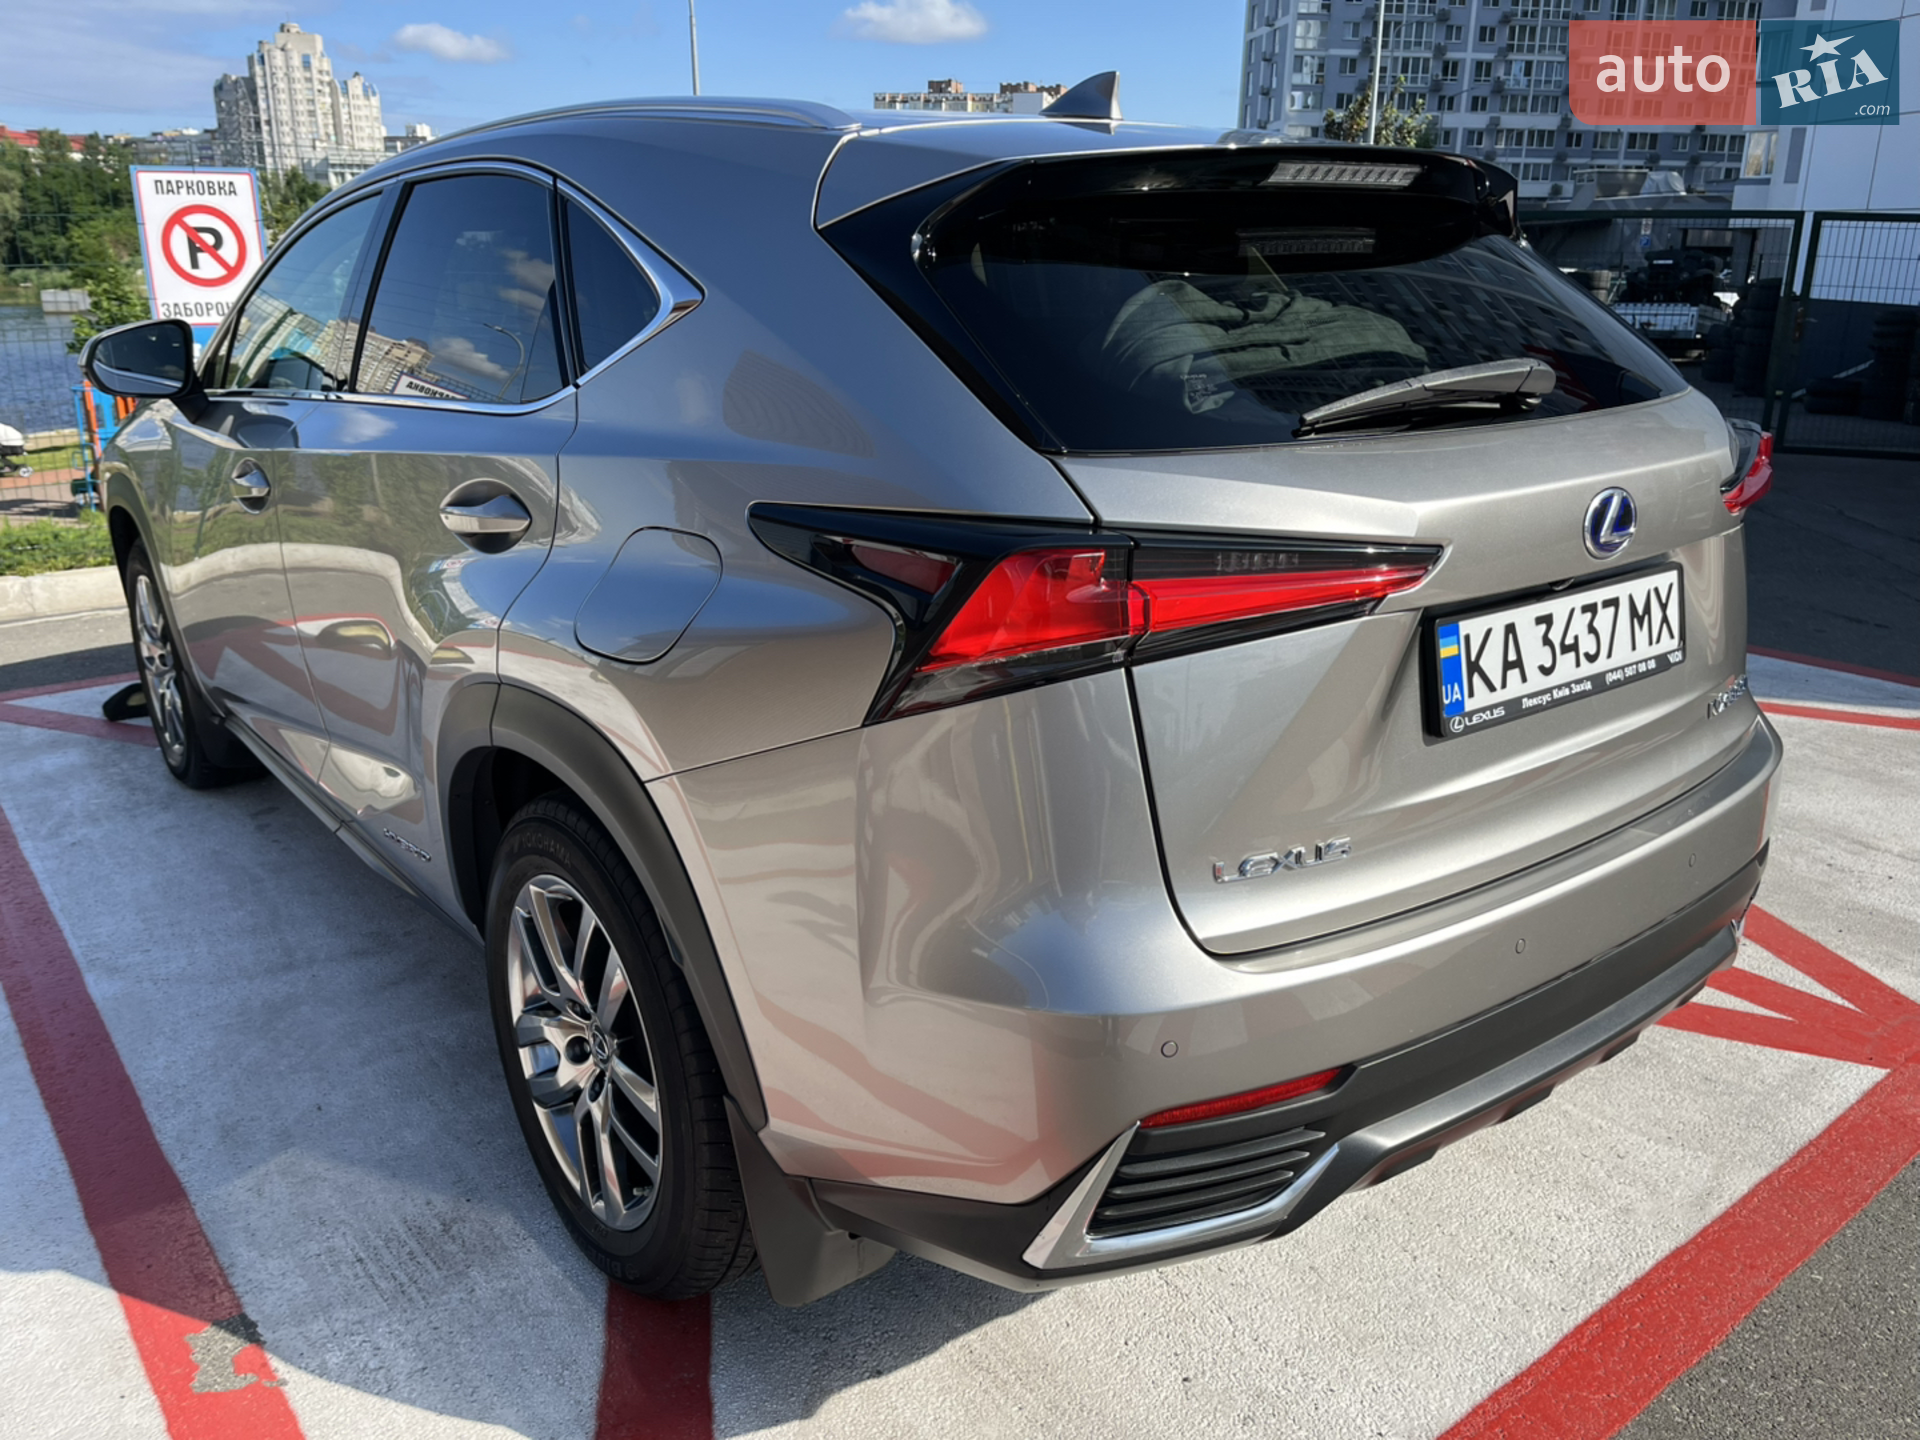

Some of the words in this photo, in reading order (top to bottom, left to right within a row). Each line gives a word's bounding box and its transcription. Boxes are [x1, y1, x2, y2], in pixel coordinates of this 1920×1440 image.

[154, 179, 237, 196] ПАРКОВКА
[1605, 669, 1624, 685] (044)
[1624, 664, 1637, 678] 507
[1442, 682, 1462, 704] UA
[1522, 693, 1552, 709] Лексус
[1552, 686, 1570, 699] Київ
[1570, 680, 1592, 694] Захід
[1465, 706, 1506, 726] LEXUS
[521, 831, 572, 869] YOKOHAMA
[1212, 836, 1353, 884] LEXUS
